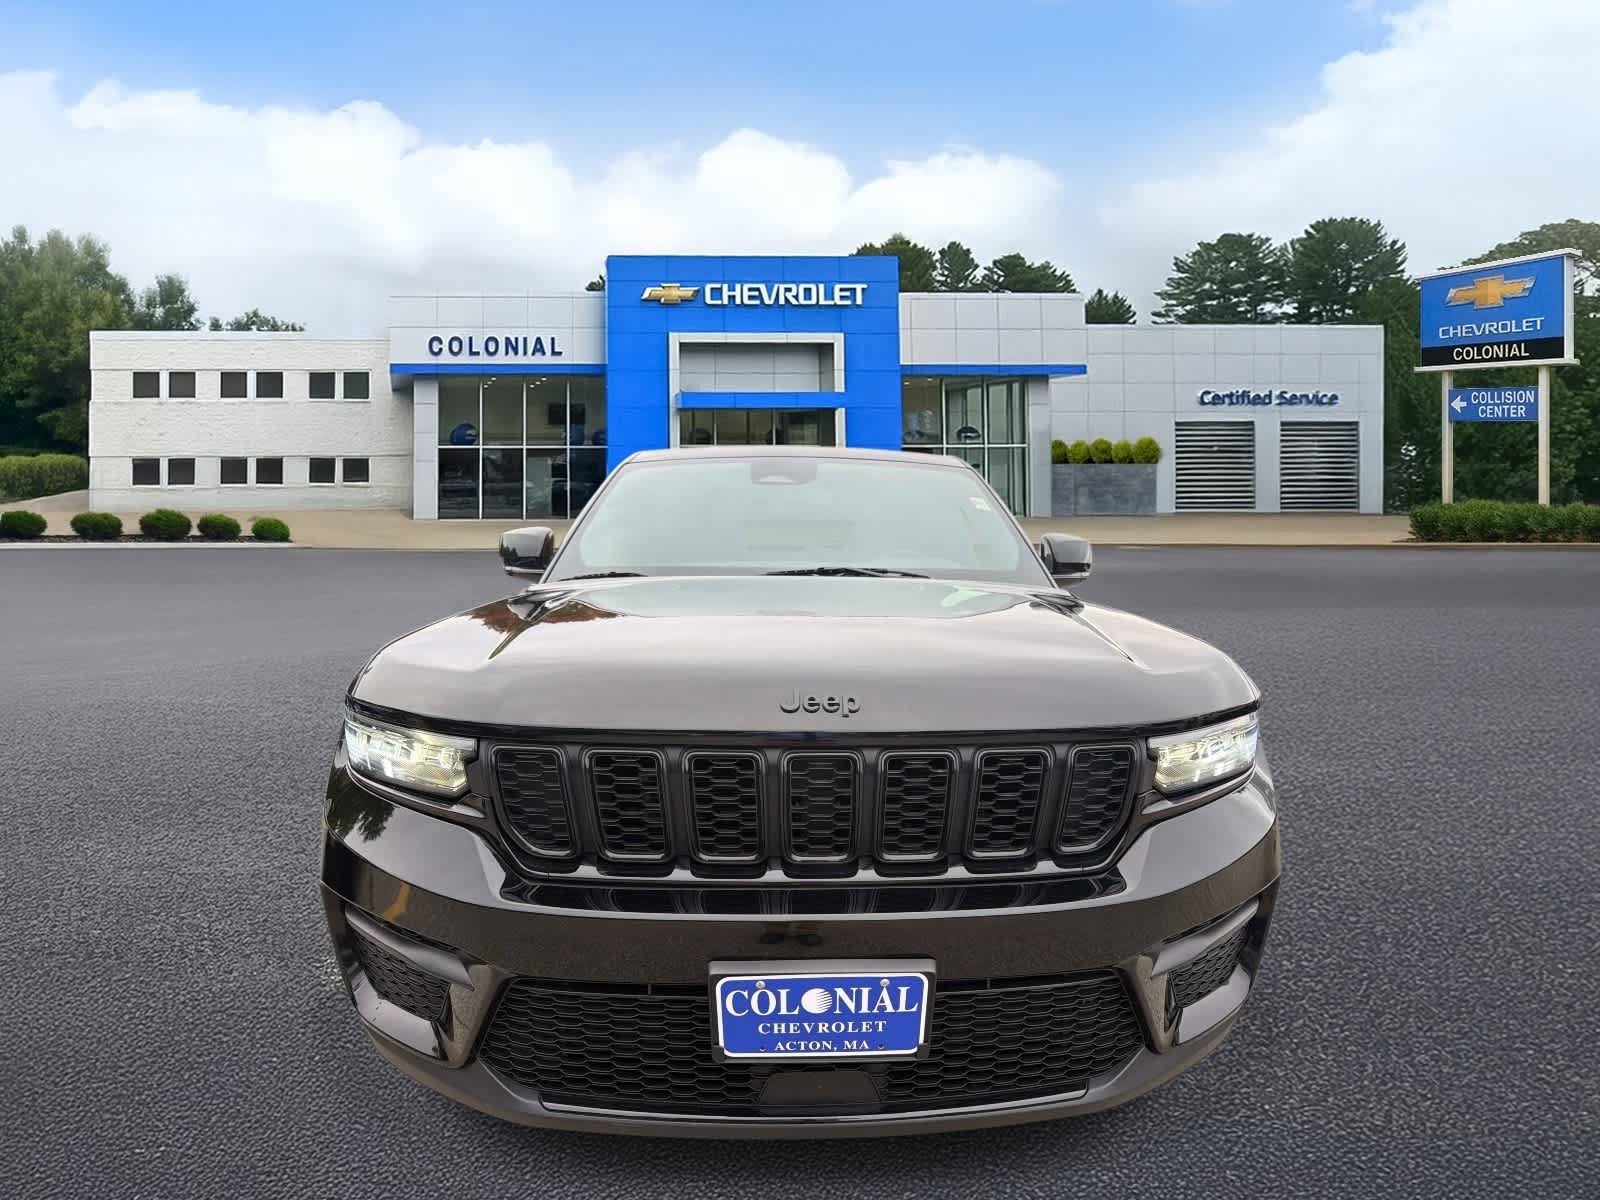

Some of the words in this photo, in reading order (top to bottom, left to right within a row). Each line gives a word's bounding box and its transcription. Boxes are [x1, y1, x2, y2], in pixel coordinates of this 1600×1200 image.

[704, 283, 868, 307] CHEVROLET
[1438, 316, 1545, 339] CHEVROLET
[428, 335, 564, 357] COLONIAL
[1453, 342, 1530, 361] COLONIAL
[1198, 388, 1273, 407] Certified
[1276, 389, 1340, 407] Service
[1471, 390, 1535, 404] COLLISION
[1478, 405, 1526, 418] CENTER
[778, 688, 861, 718] Jeep
[725, 984, 918, 1017] COLONIAL
[757, 1020, 887, 1035] CHEVROLET
[774, 1040, 837, 1052] ACTON,
[843, 1040, 870, 1051] MA
